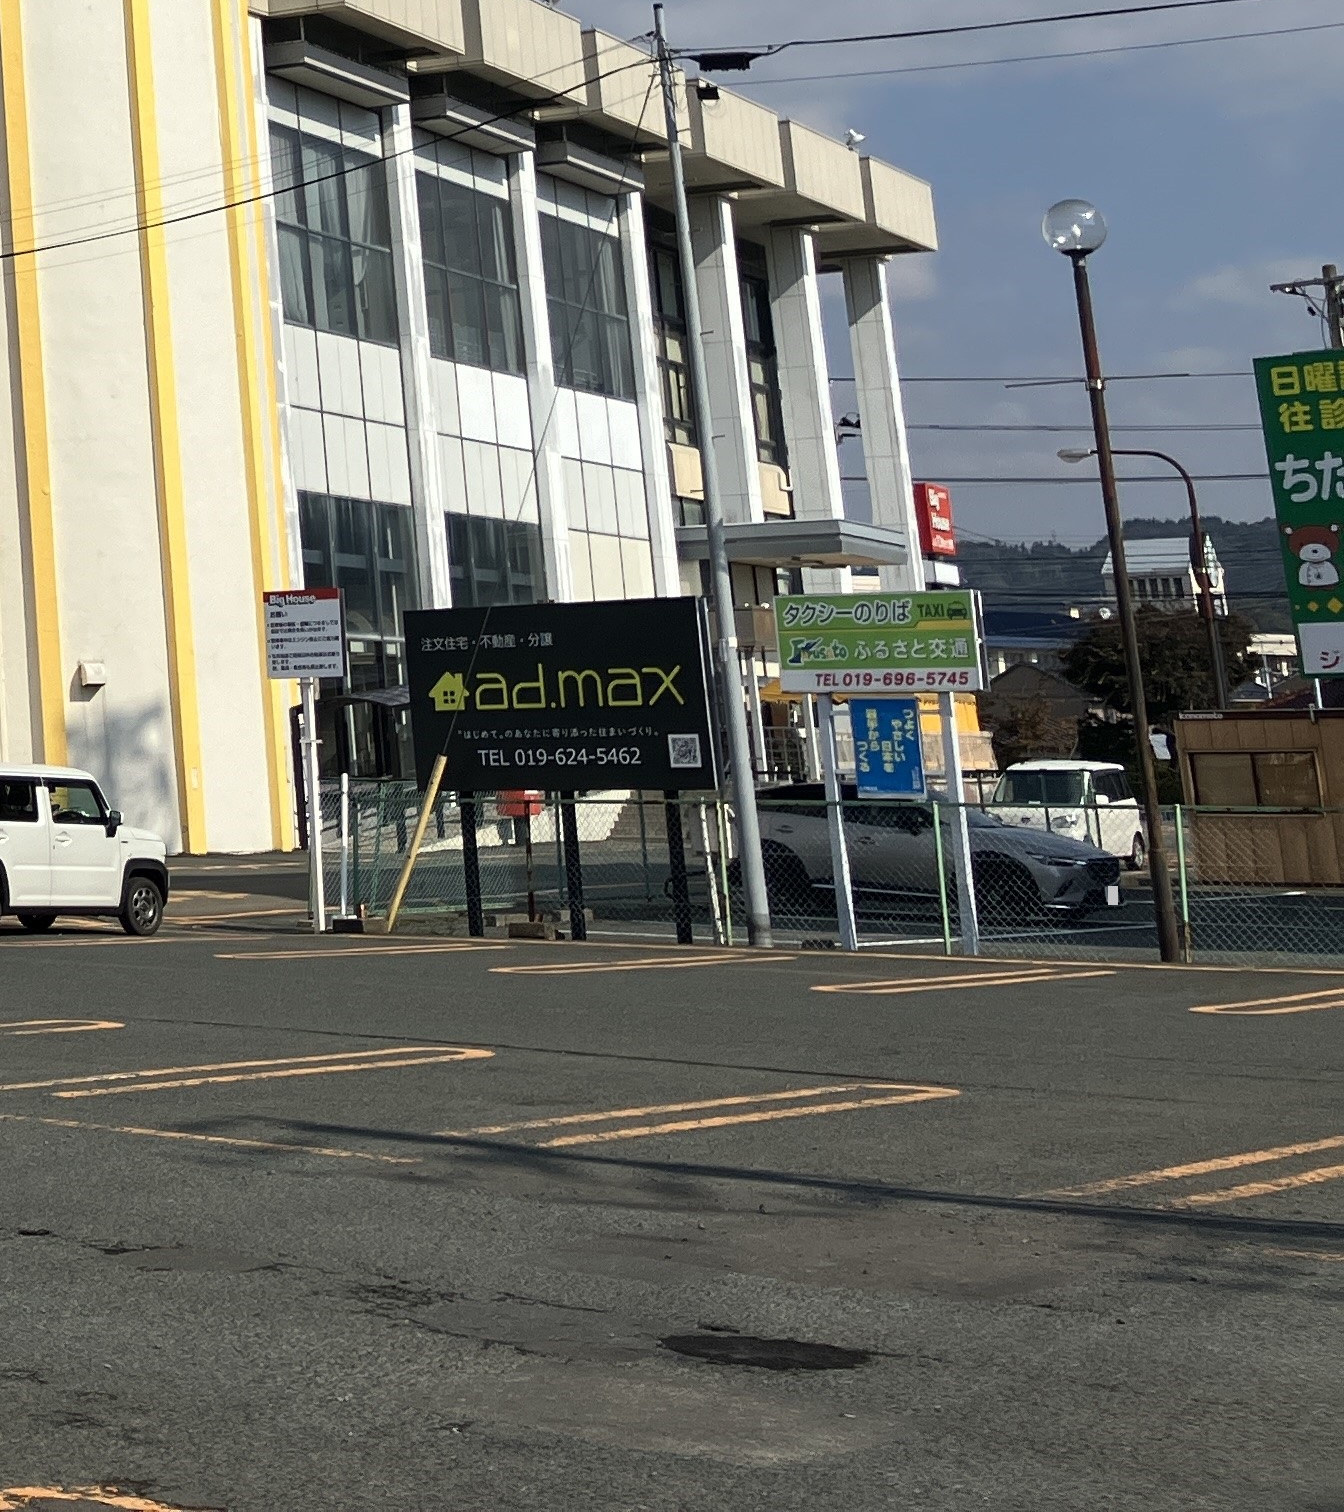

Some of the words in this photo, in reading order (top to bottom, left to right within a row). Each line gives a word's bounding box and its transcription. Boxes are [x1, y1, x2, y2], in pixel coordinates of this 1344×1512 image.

[1270, 360, 1344, 397] 日曜
[269, 594, 285, 606] Big
[285, 594, 316, 605] House
[783, 599, 912, 627] タクシーのりば
[917, 603, 945, 618] TAXI
[853, 638, 970, 660] ふるさと交通
[815, 673, 840, 687] TEL
[842, 672, 969, 686] 019-696-5745
[477, 749, 511, 767] TEL
[514, 747, 642, 766] 019-624-5462
